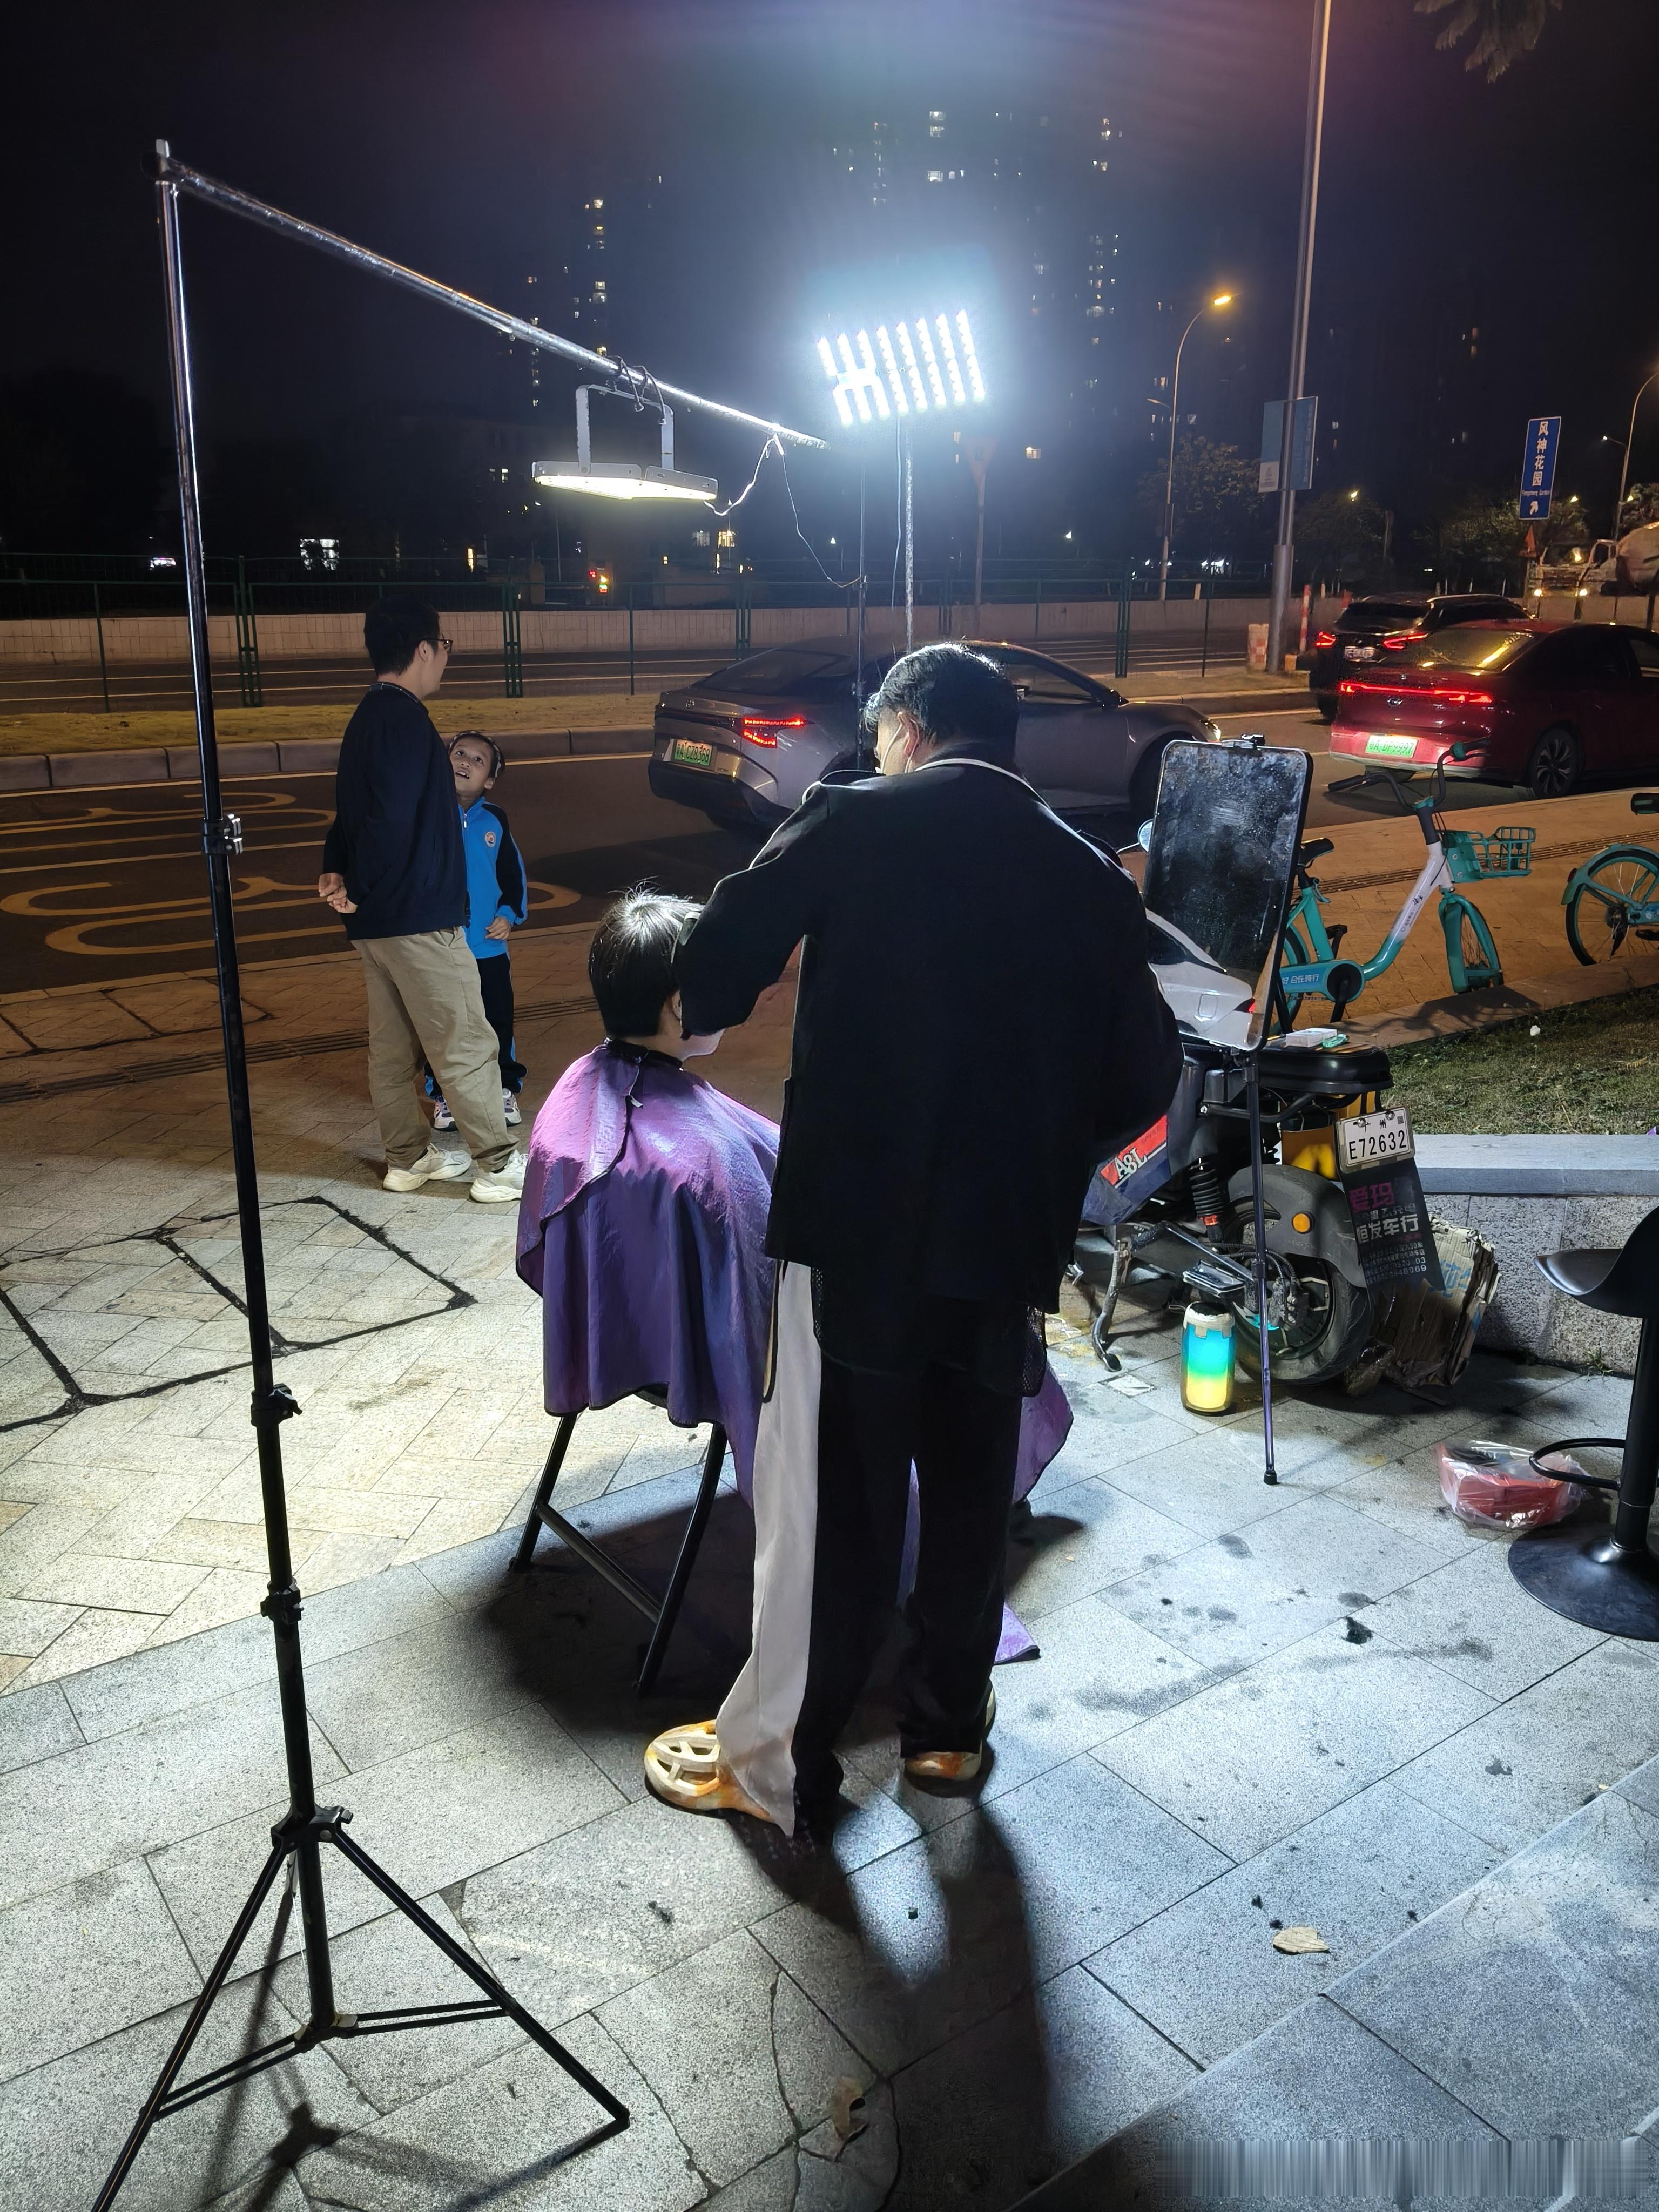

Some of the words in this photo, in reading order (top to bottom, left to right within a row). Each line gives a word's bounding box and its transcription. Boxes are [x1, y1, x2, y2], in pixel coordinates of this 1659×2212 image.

[1532, 421, 1548, 486] 风神花园
[1291, 974, 1320, 984] 自在骑行
[1349, 1130, 1407, 1160] E72632
[1114, 1147, 1148, 1180] A8L
[1356, 1214, 1419, 1244] 恒发车行
